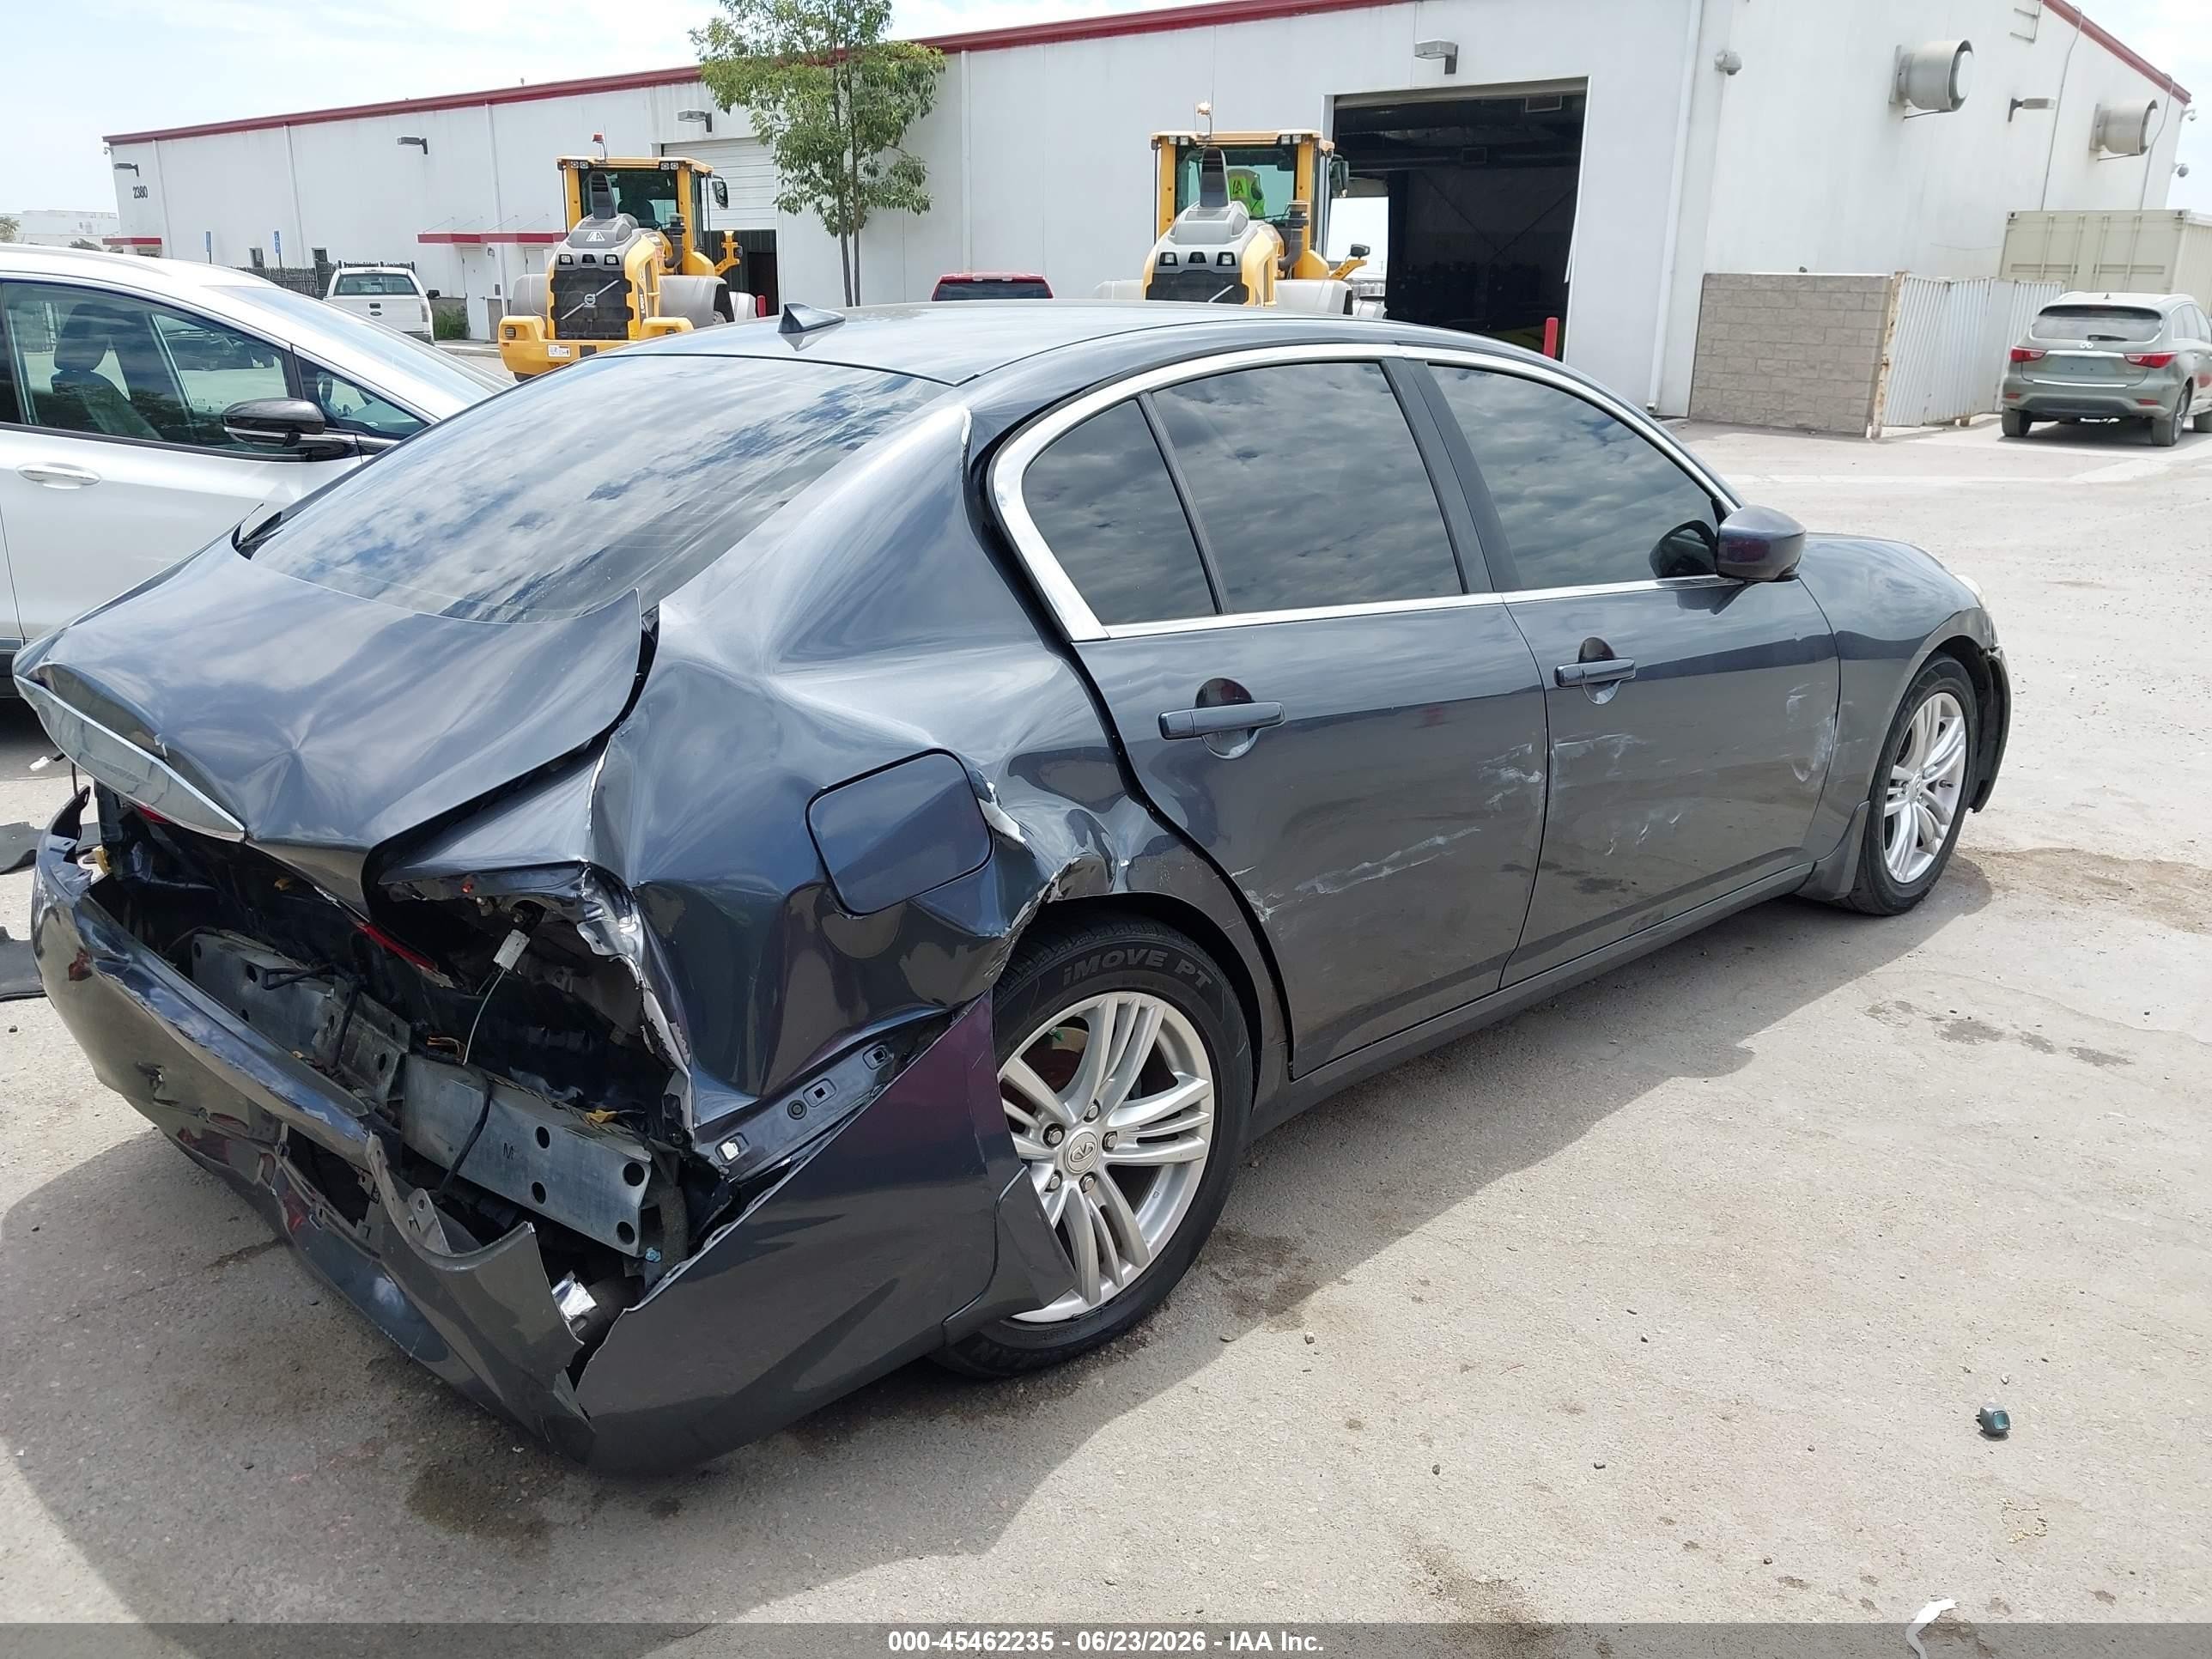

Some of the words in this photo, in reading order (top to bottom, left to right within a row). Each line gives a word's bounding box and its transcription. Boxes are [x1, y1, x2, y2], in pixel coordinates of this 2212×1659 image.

[132, 185, 149, 199] 2380
[1062, 948, 1169, 987] iMOVE
[1174, 958, 1212, 989] PT
